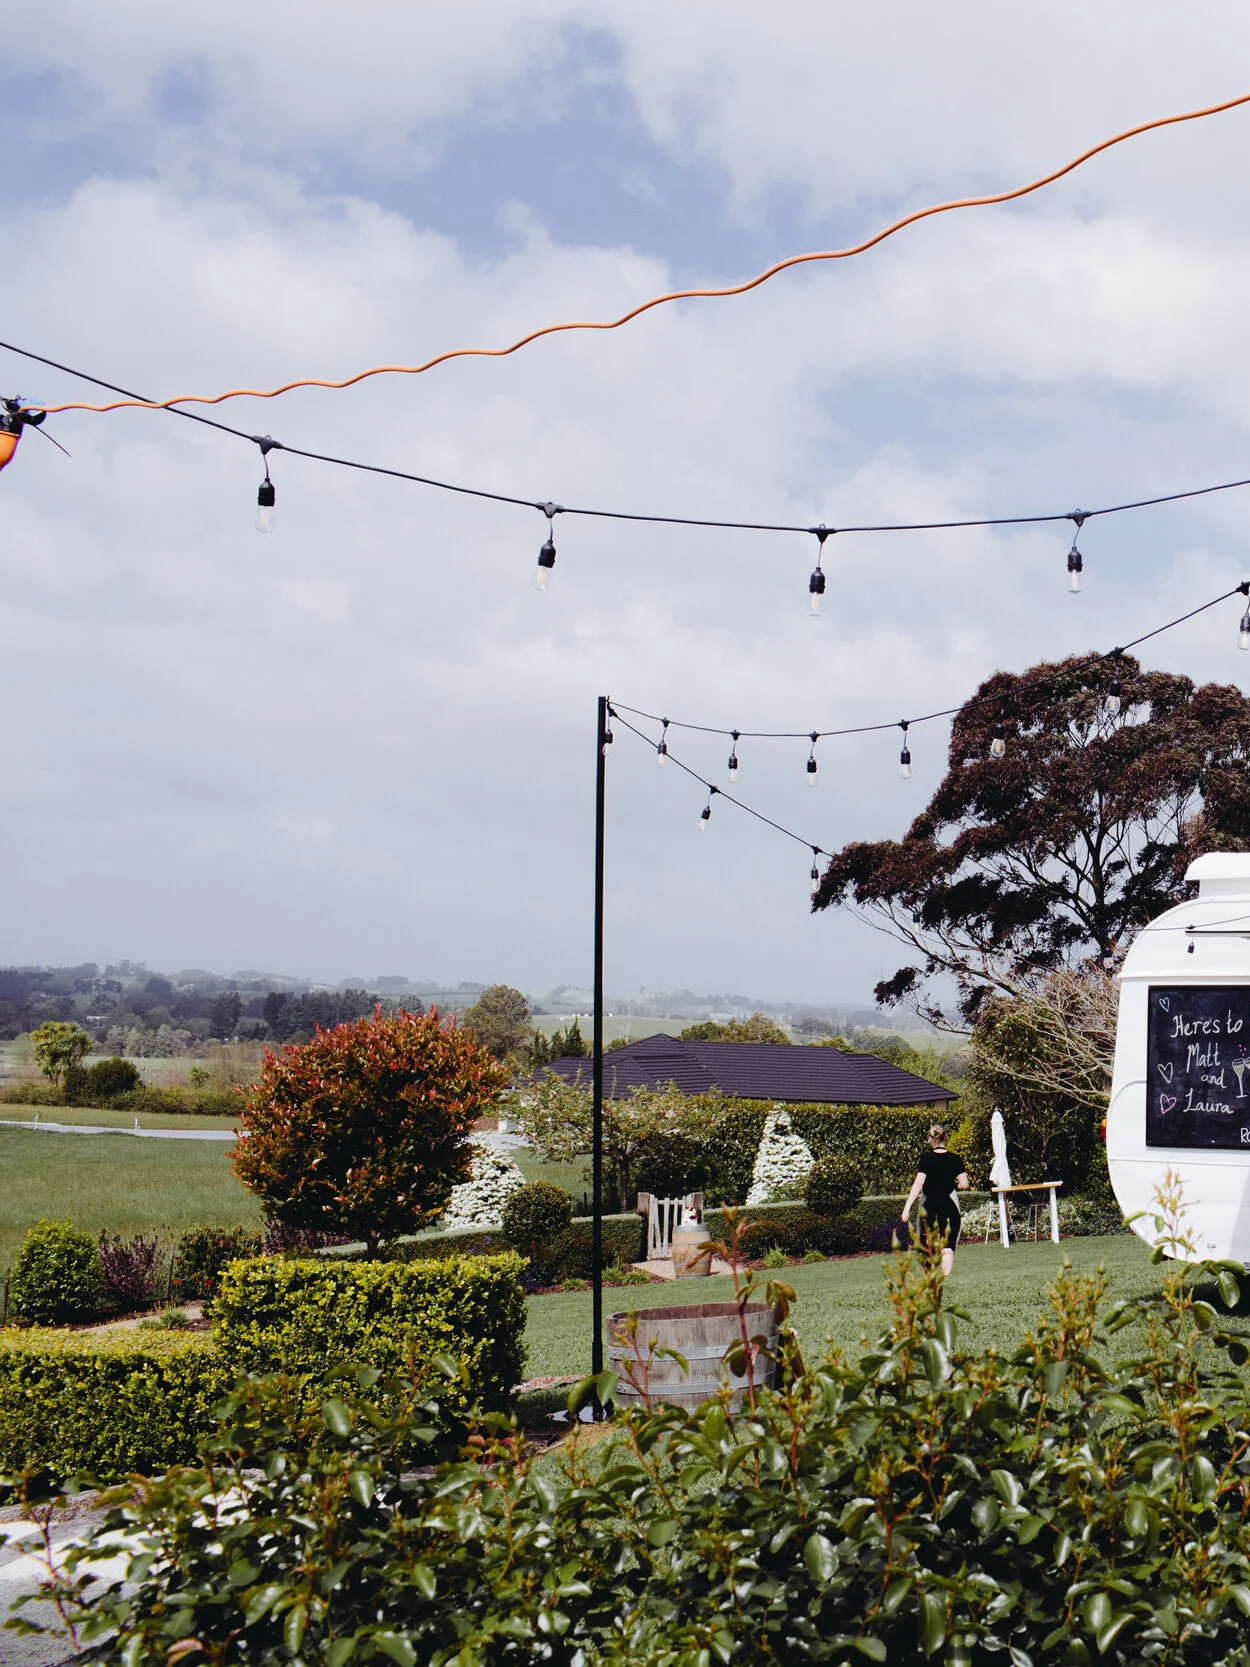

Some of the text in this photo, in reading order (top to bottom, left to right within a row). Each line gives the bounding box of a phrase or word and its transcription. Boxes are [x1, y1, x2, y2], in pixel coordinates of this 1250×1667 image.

[1171, 1009, 1243, 1038] Here's to
[1187, 1042, 1221, 1073] Matt
[1201, 1068, 1227, 1089] and
[1183, 1088, 1234, 1114] Laura
